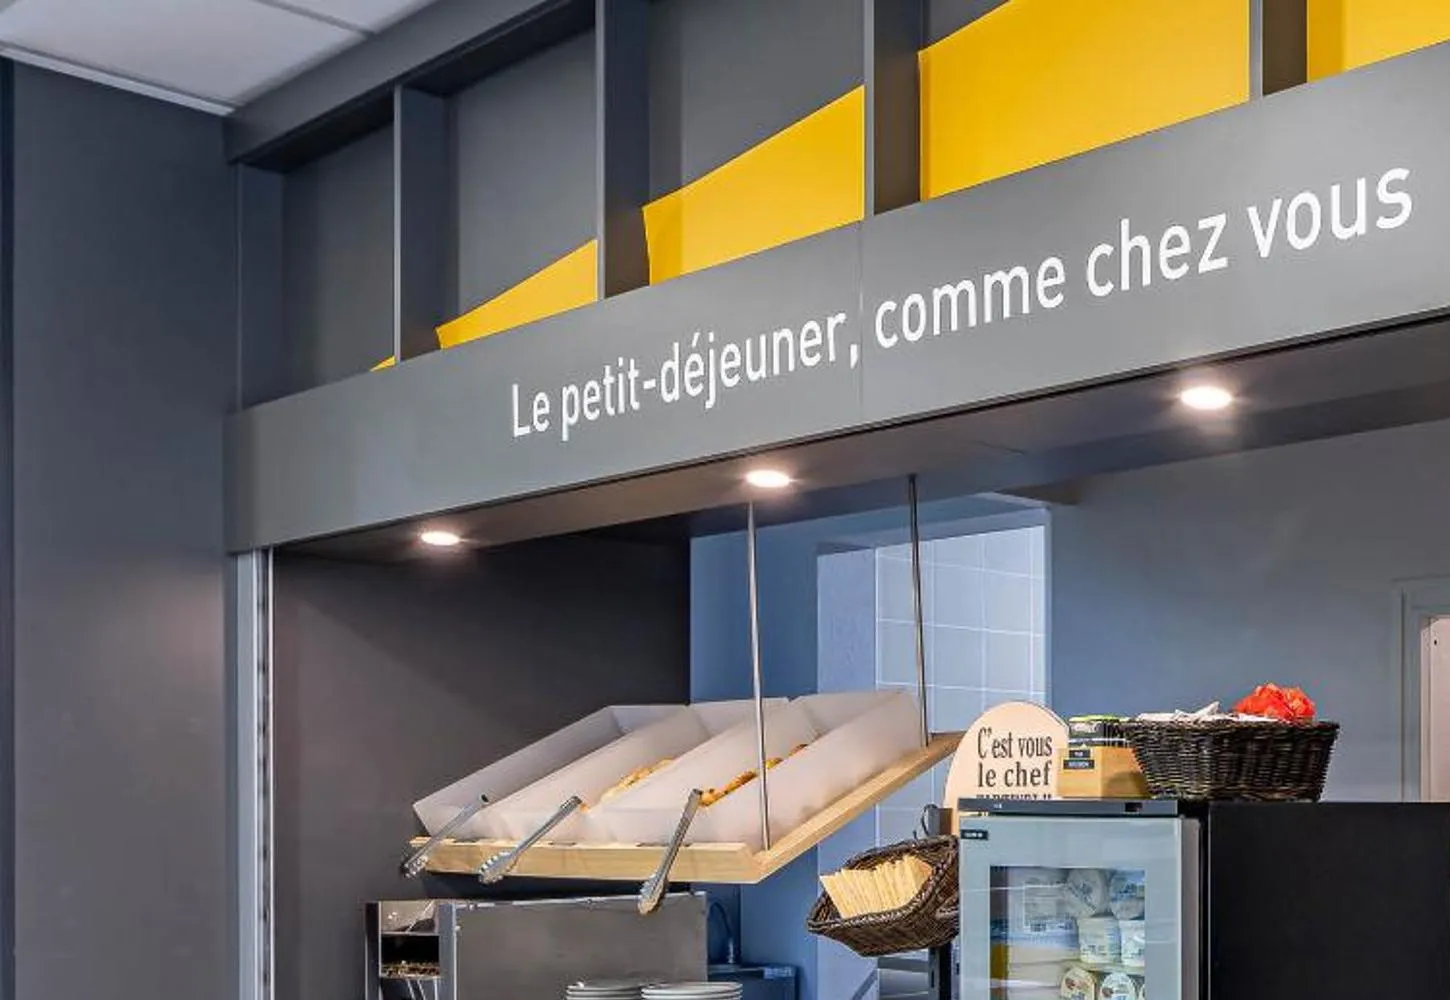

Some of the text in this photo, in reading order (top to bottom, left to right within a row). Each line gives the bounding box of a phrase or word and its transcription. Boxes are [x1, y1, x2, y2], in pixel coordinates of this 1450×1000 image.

[512, 166, 1414, 442] Le petit-déjeuner, comme chez vous
[977, 726, 1053, 759] C'est vous
[977, 760, 1053, 788] le chef
